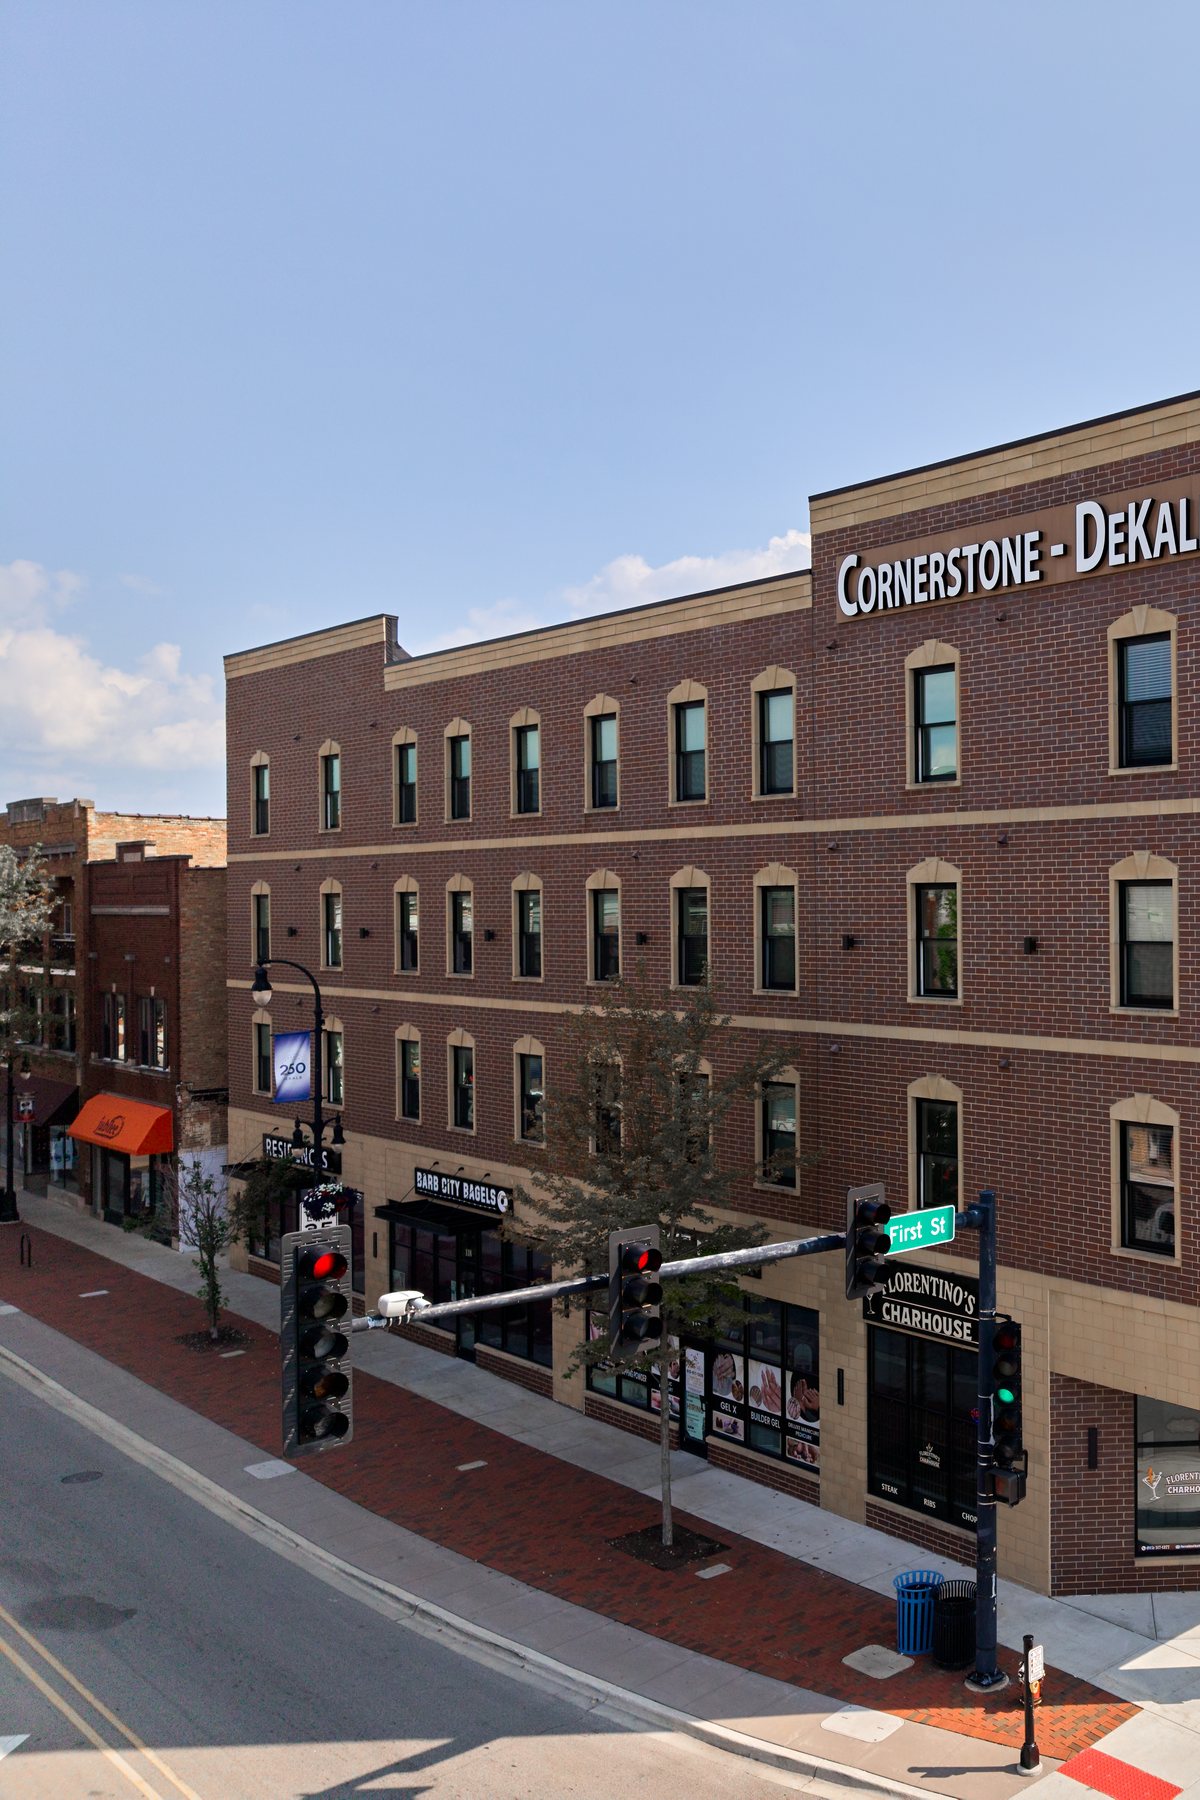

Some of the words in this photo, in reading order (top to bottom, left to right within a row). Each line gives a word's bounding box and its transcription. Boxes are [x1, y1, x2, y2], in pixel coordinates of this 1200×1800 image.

[279, 1062, 306, 1076] 250
[265, 1138, 328, 1169] RESINCS
[416, 1171, 439, 1192] BARB
[441, 1178, 461, 1197] CITY
[462, 1181, 497, 1206] BAGELS
[889, 1221, 923, 1245] First
[930, 1216, 946, 1236] St
[881, 1302, 973, 1341] CHARHOUSE
[720, 1401, 732, 1412] GEL
[732, 1405, 737, 1414] X
[750, 1410, 771, 1426] BUILDER
[770, 1418, 781, 1429] GEL
[881, 1483, 898, 1495] STEAK
[923, 1498, 937, 1509] RIBS
[961, 1511, 978, 1524] CHOP
